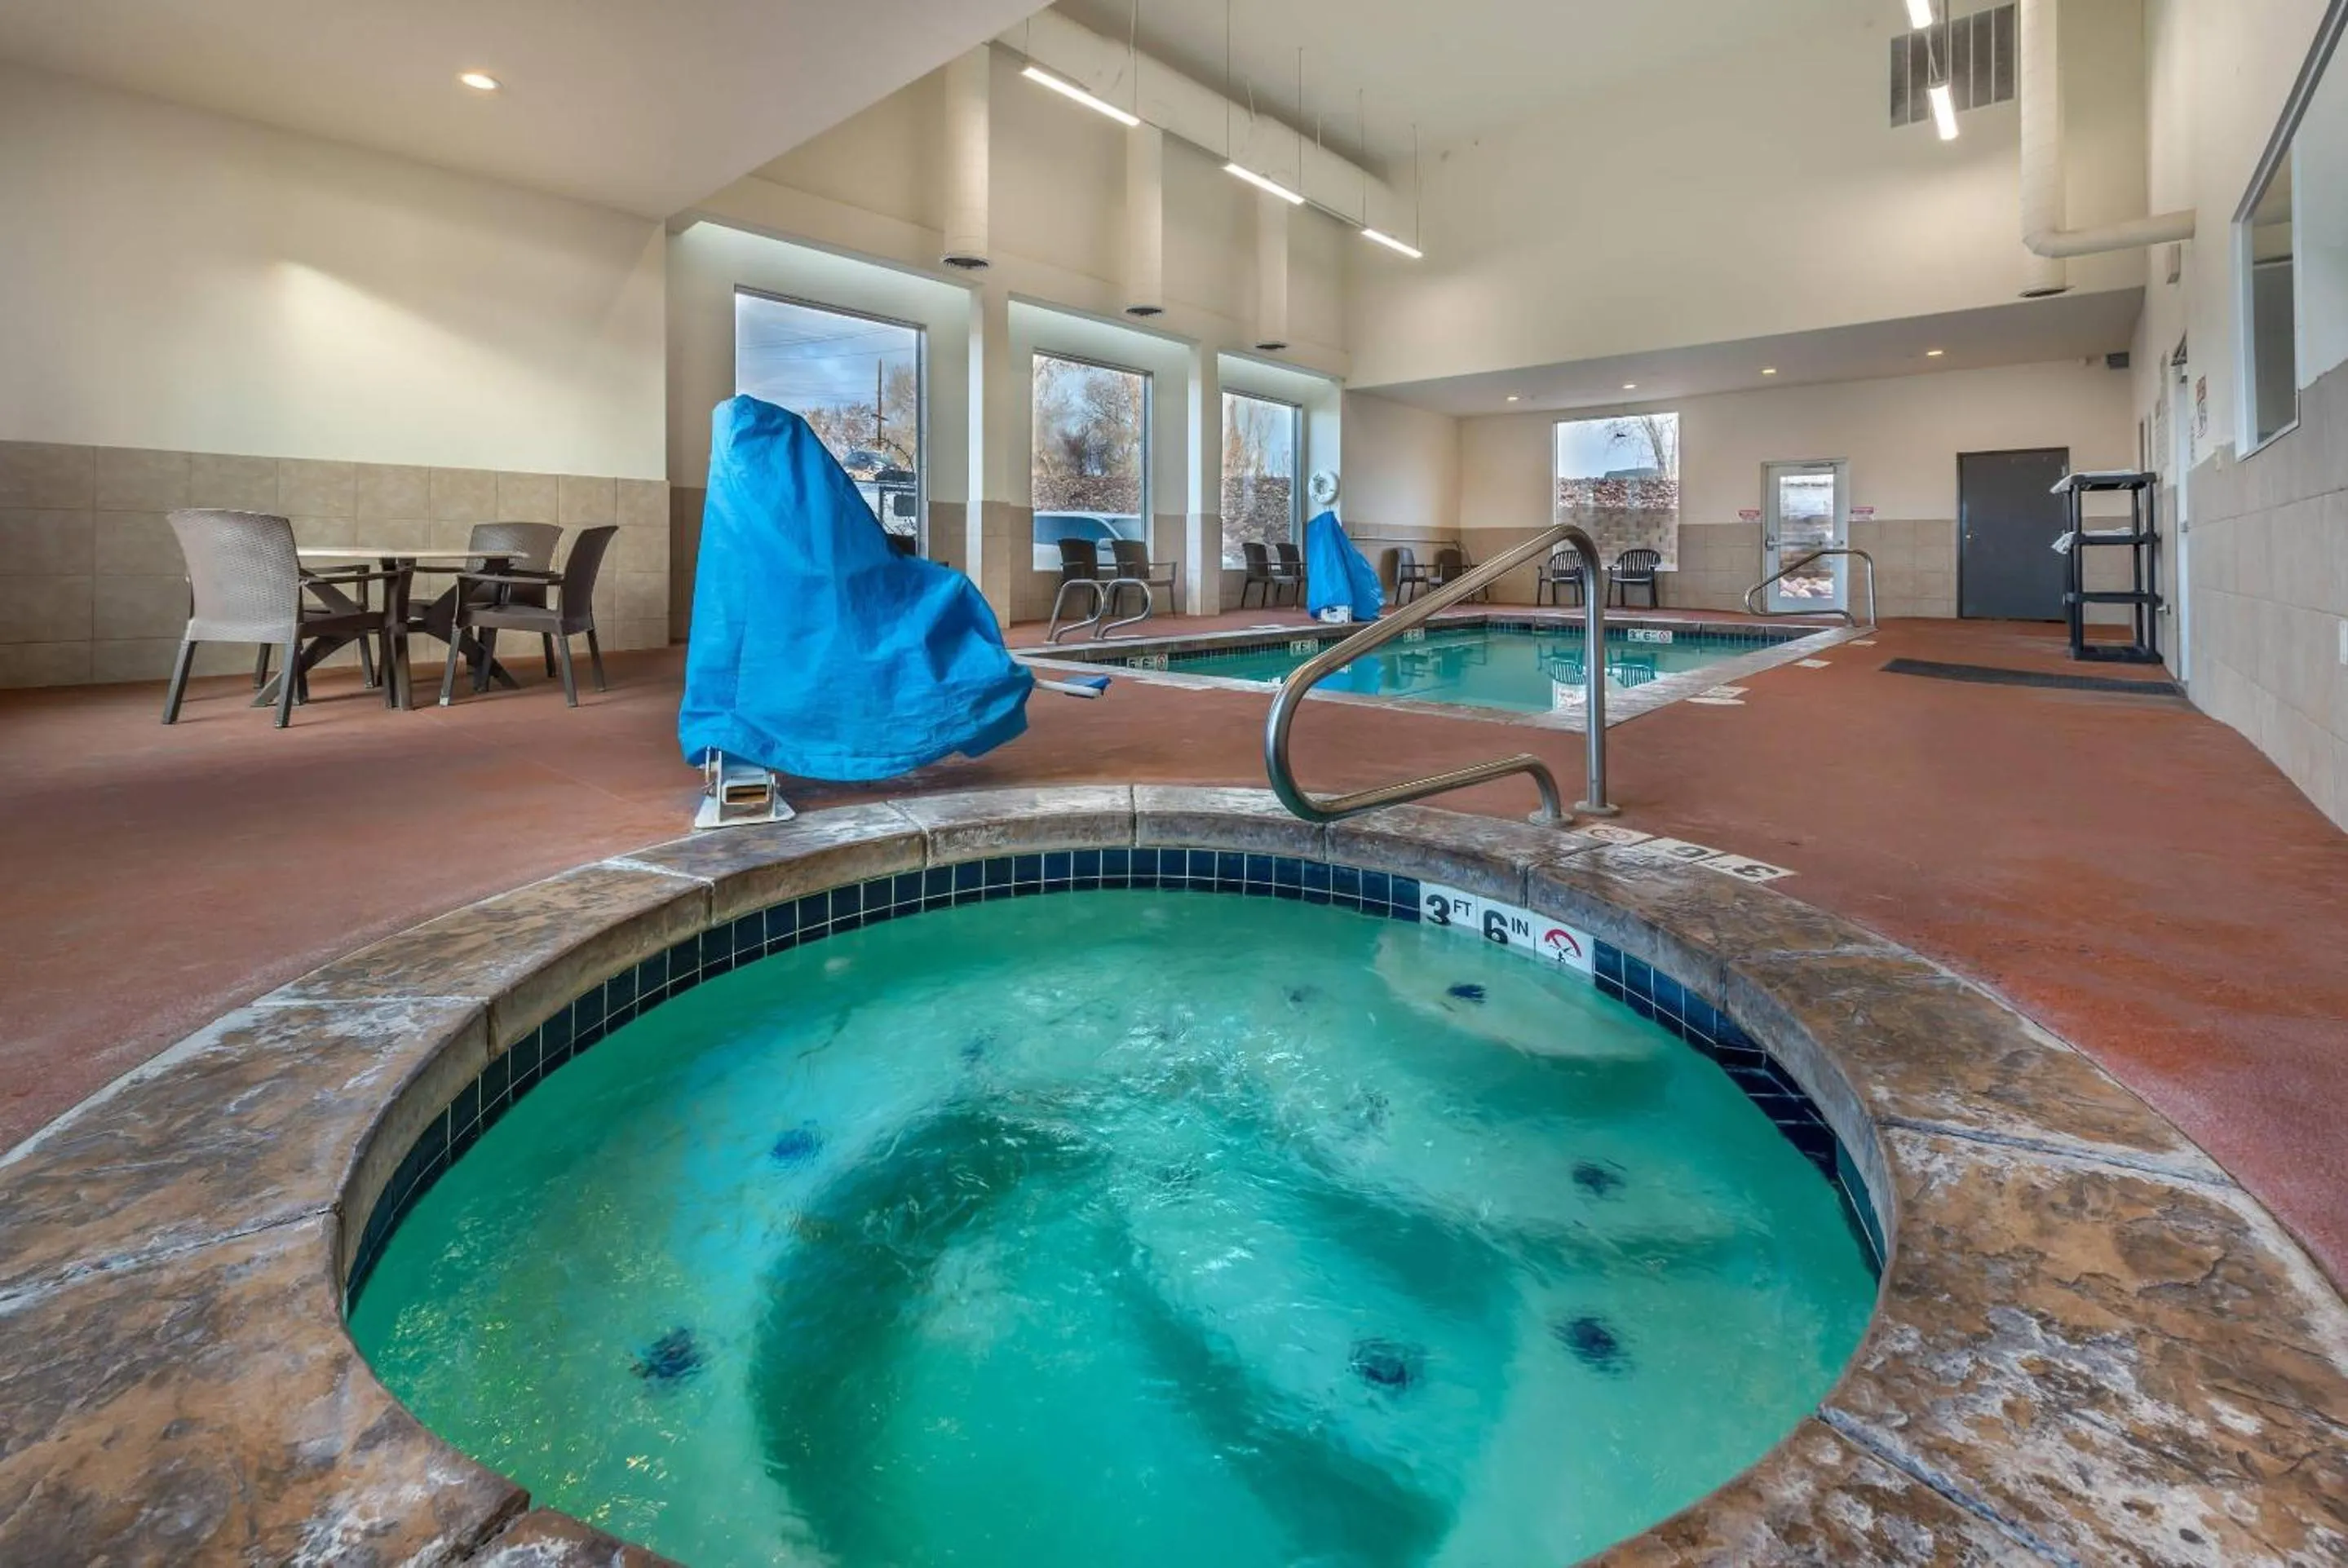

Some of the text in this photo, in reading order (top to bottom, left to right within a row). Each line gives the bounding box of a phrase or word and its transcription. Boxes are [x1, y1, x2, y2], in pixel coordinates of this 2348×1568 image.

[1426, 894, 1529, 944] 3 FT 6 IN
